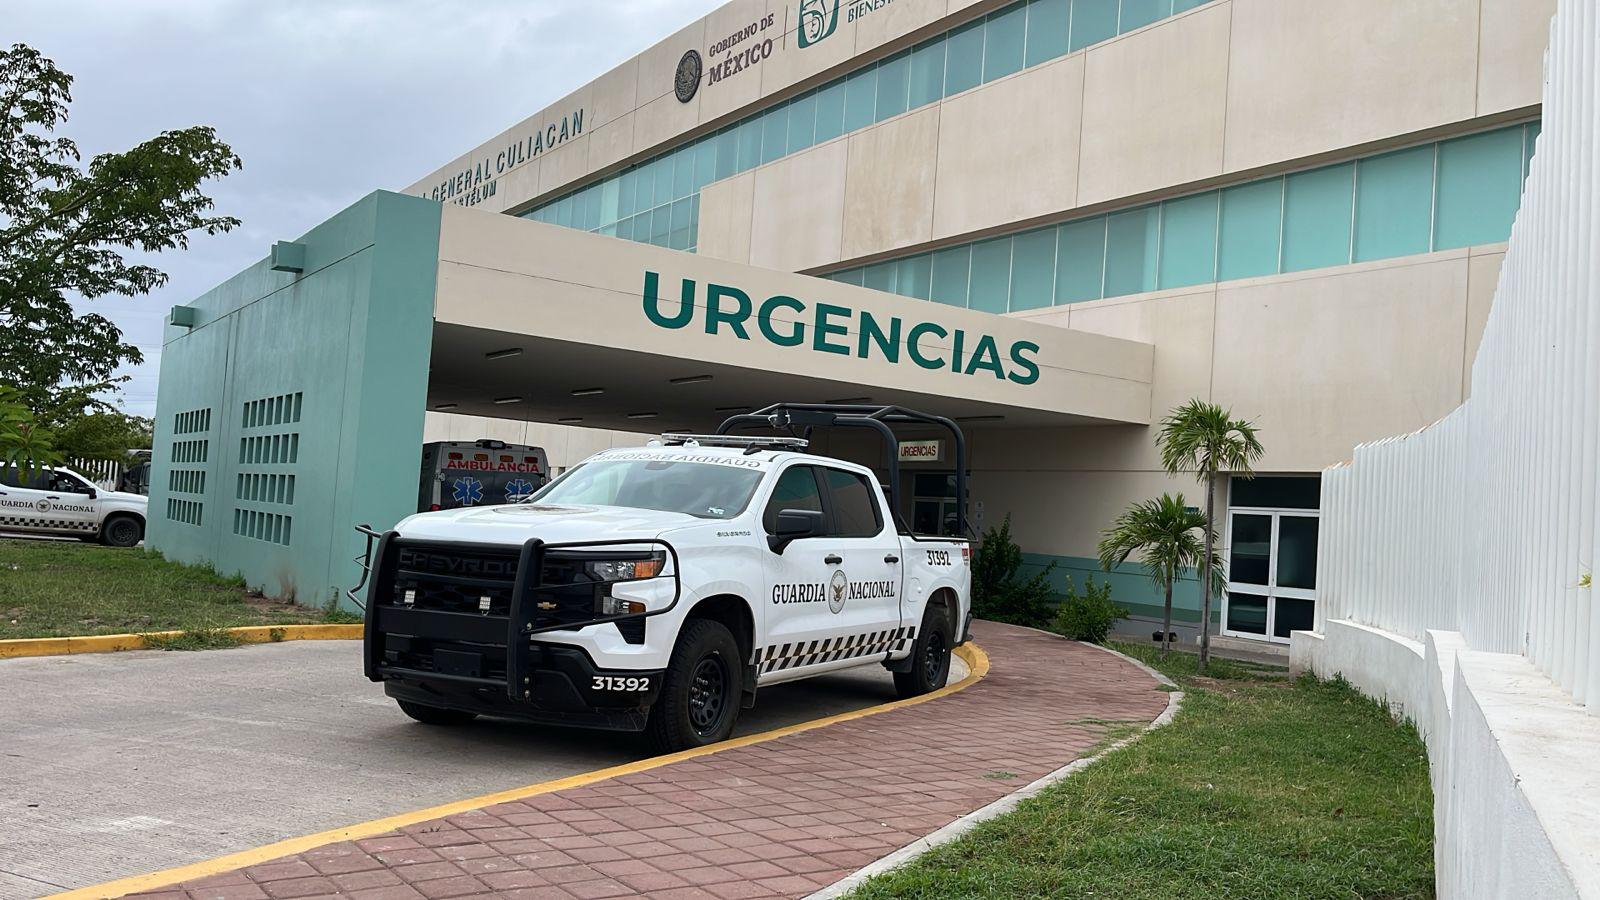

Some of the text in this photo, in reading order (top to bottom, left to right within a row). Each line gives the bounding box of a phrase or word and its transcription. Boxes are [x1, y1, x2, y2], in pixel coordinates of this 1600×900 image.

[848, 0, 894, 23] BIENES
[709, 13, 775, 57] GOBIERNO DE
[707, 38, 773, 86] MÉXICO
[431, 108, 584, 202] GENERAL CULIACAN
[642, 271, 1041, 386] URGENCIAS
[900, 445, 936, 457] URGENCIAS
[447, 460, 539, 473] AMBULANCIA
[1, 500, 95, 513] UARDIA NACIONAL
[926, 550, 951, 566] 31392
[772, 580, 895, 605] GUARDIA NACIONAL
[591, 675, 650, 692] 31392
